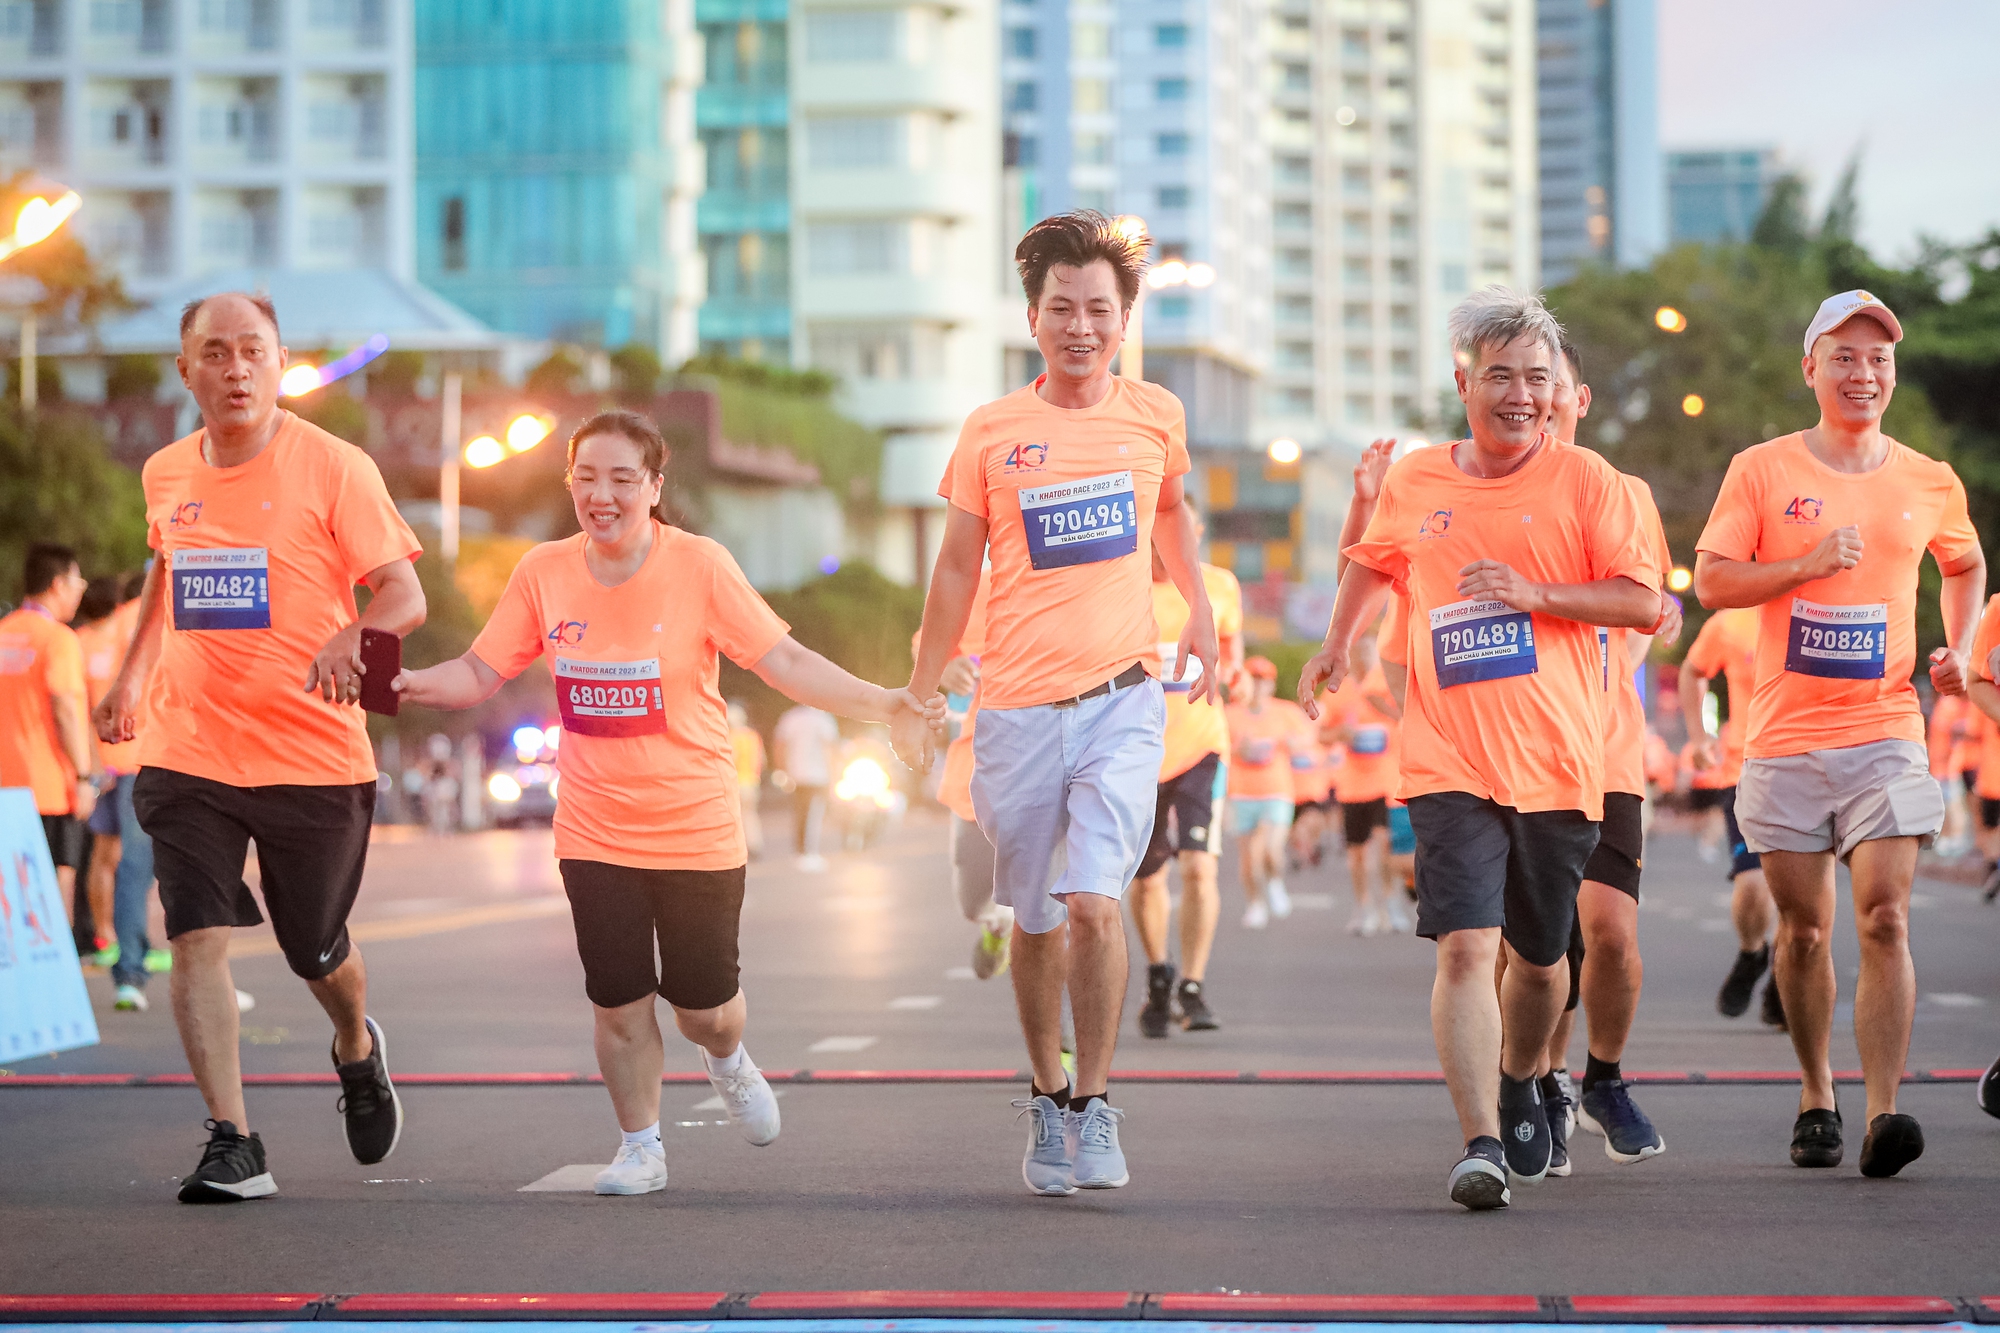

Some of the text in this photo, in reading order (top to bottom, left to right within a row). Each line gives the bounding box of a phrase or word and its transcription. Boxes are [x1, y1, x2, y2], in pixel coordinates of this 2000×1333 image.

[1039, 488, 1072, 500] KHATOCO
[1073, 484, 1091, 494] RACE
[1092, 481, 1111, 491] 2023
[1038, 501, 1124, 536] 790496
[186, 555, 212, 563] KHATOCO
[230, 554, 247, 562] 2023
[181, 575, 256, 597] 790482
[1443, 602, 1506, 620] KHATOCO RACE 2023
[1805, 607, 1834, 618] KHATOCO
[1440, 621, 1519, 655] 790489
[1800, 625, 1874, 650] 790826
[570, 665, 598, 674] KHATOCO
[618, 667, 636, 675] 2023
[569, 685, 648, 707] 680209
